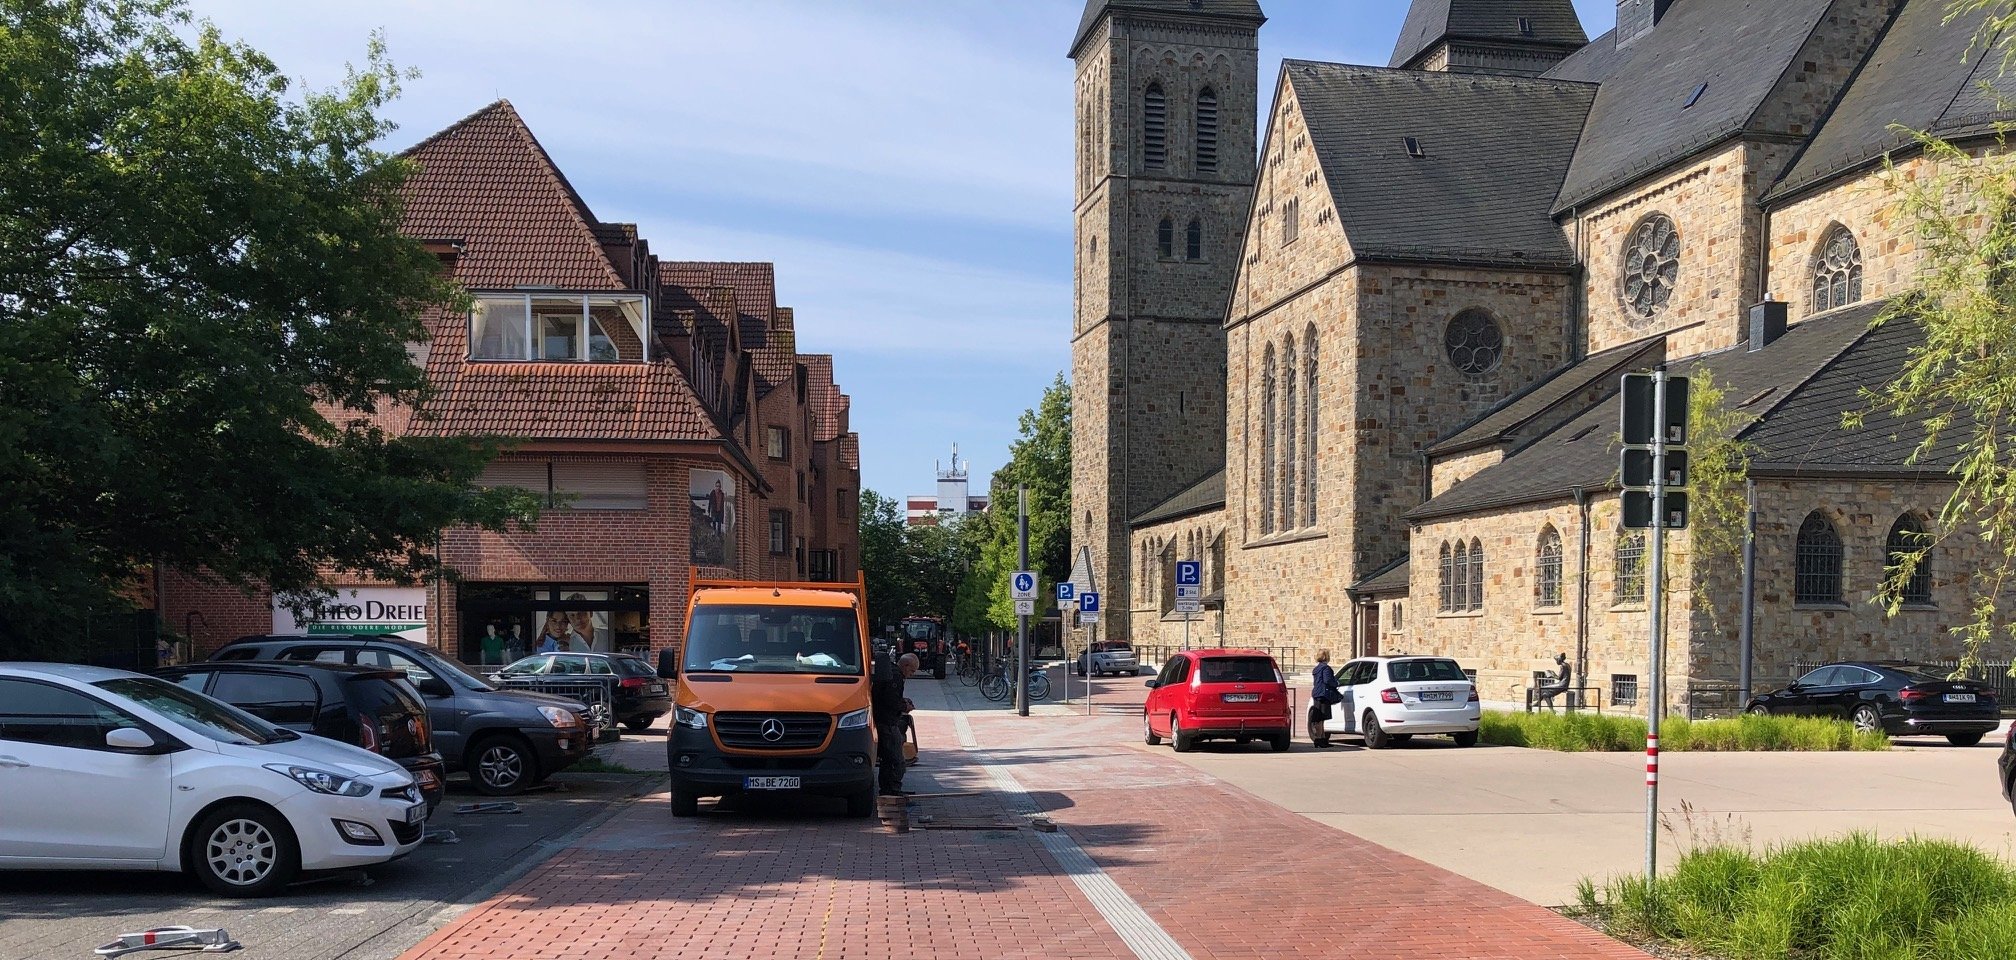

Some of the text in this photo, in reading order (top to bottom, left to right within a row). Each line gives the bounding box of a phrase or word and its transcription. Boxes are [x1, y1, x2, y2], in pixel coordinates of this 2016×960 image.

[1181, 564, 1195, 582] P
[1060, 585, 1069, 598] P
[1084, 595, 1095, 610] P
[749, 778, 799, 787] MS BE 7200
